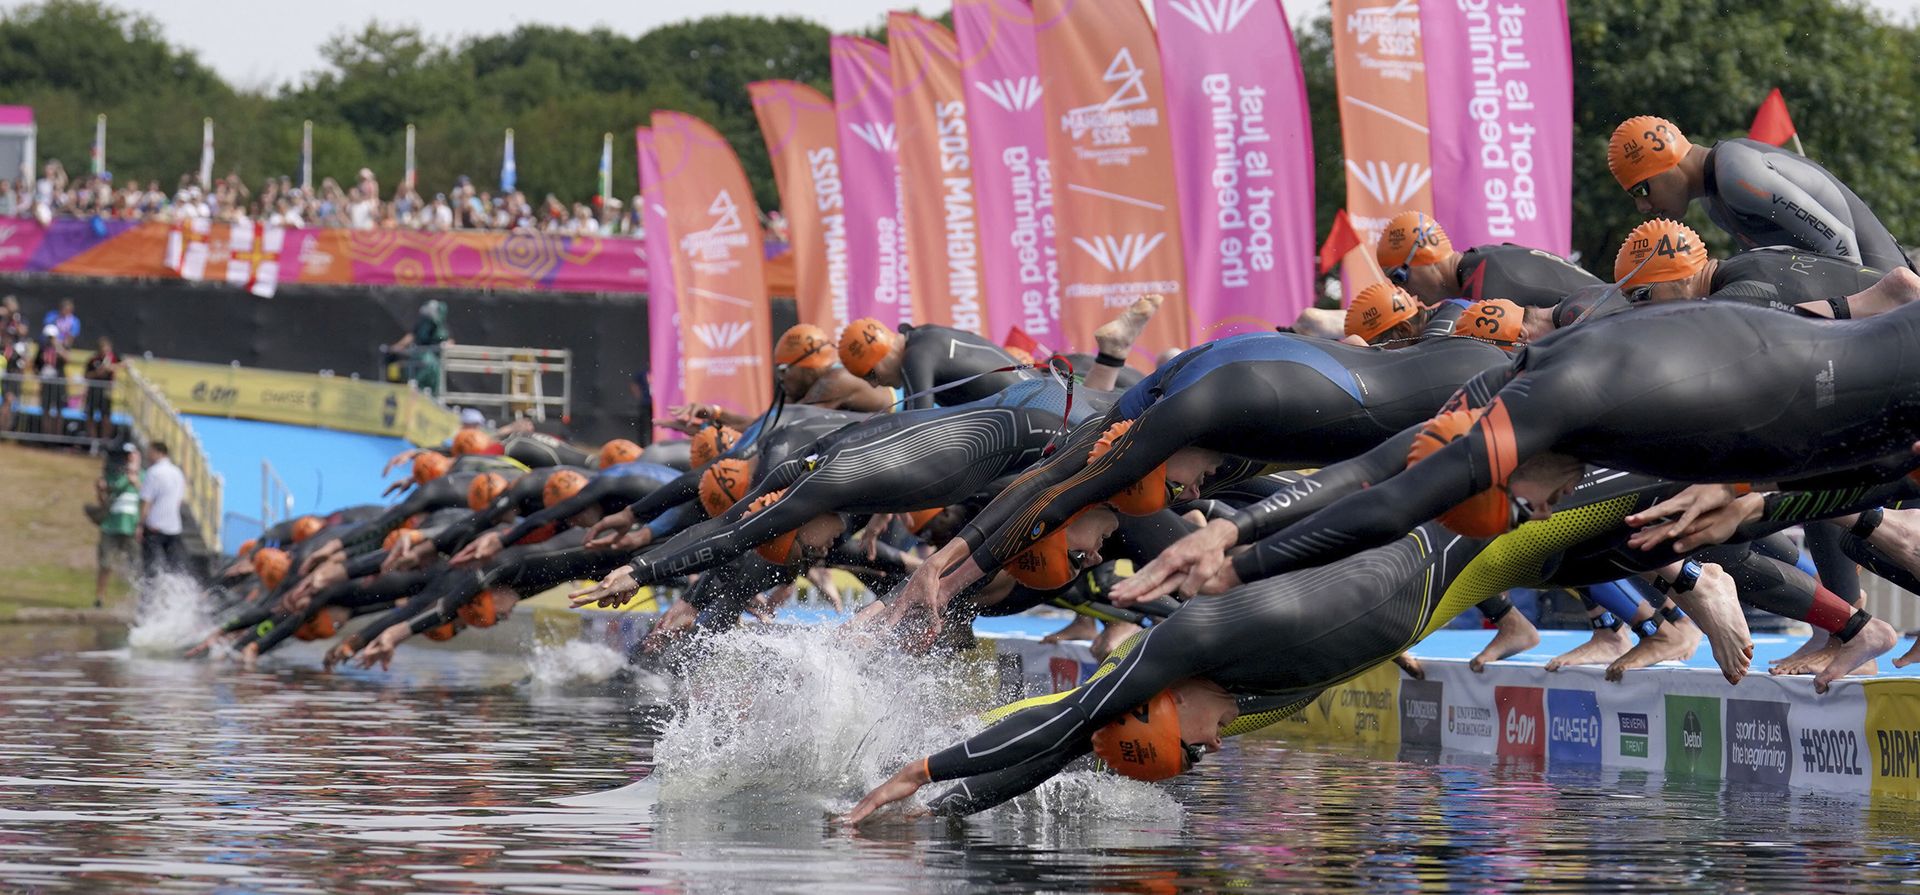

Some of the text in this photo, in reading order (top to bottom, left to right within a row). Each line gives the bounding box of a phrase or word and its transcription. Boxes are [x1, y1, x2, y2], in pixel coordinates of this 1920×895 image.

[1623, 139, 1638, 153] FIJ
[1643, 125, 1676, 152] 33
[1771, 193, 1837, 241] V-FORCE
[1632, 238, 1650, 250] TTO
[1657, 231, 1692, 259] 44
[1362, 306, 1379, 320] IND
[1475, 304, 1506, 334] 39
[1551, 716, 1588, 743] CHASE
[1621, 717, 1646, 729] SEVERN
[1735, 719, 1783, 746] sport is just
[1625, 740, 1644, 753] TRENT
[1683, 729, 1702, 748] Dettol
[1800, 728, 1863, 775] #B2022
[1732, 742, 1786, 774] the beginning
[1876, 730, 1920, 778] BIRM
